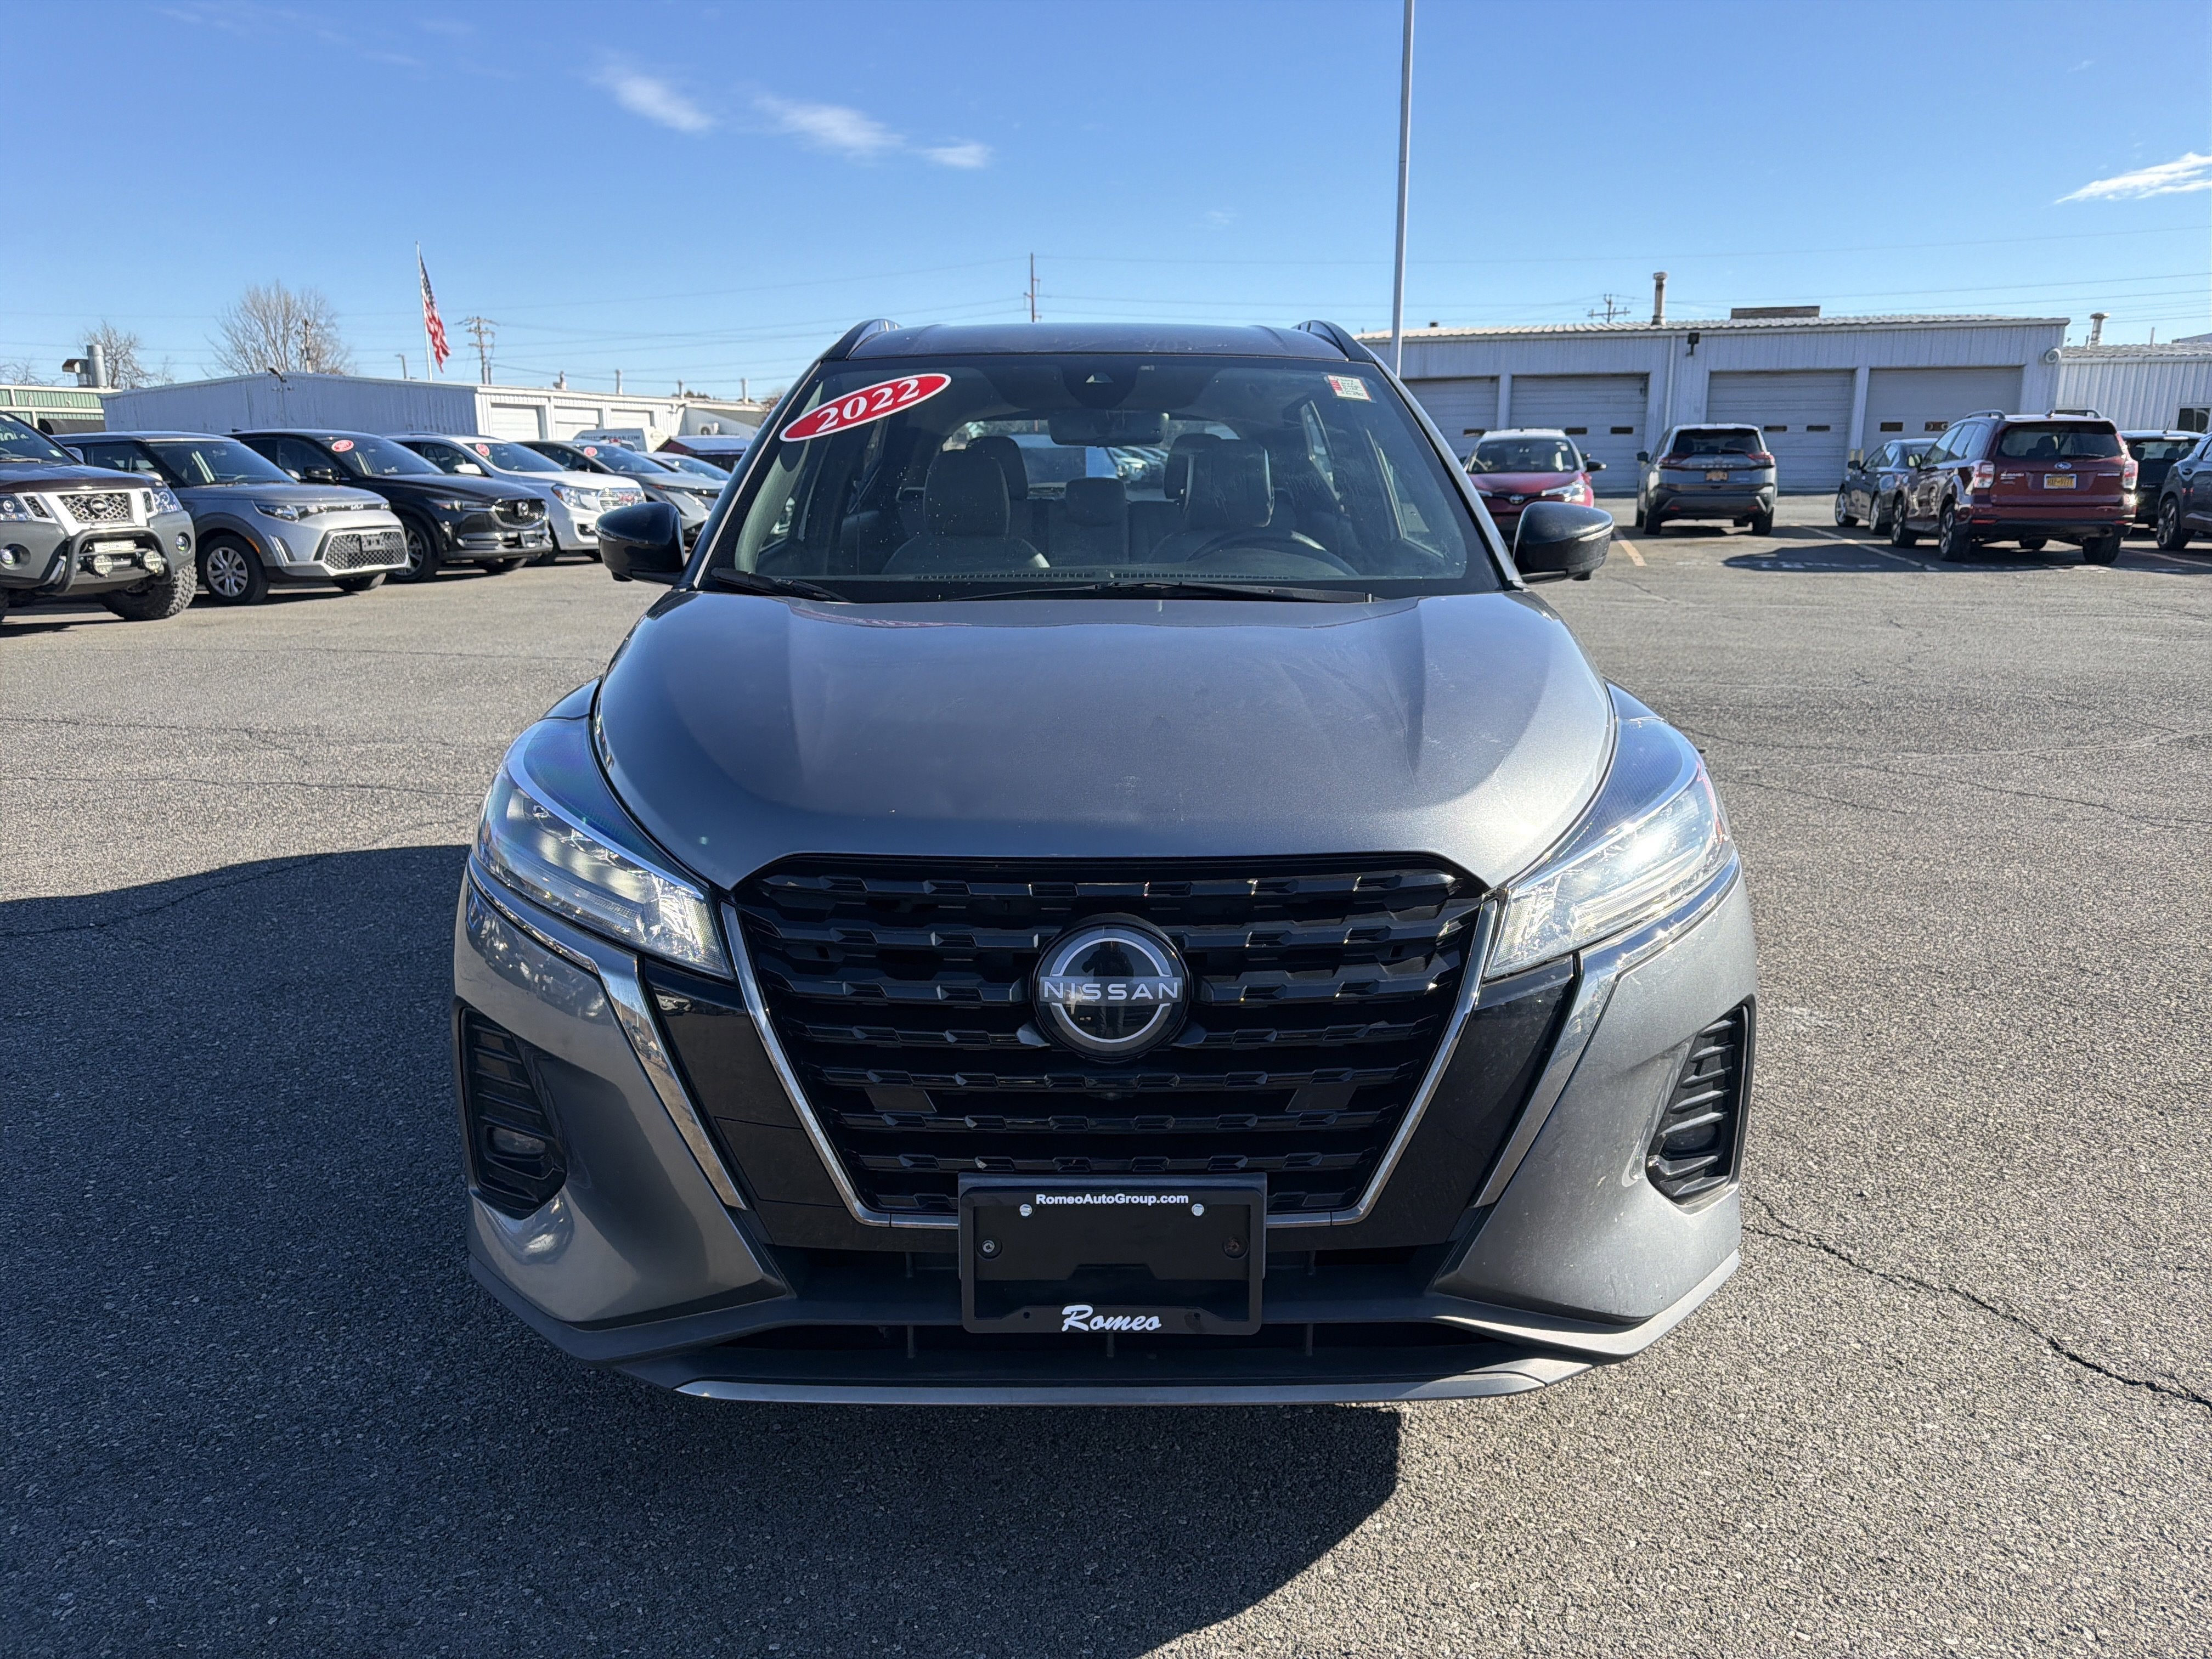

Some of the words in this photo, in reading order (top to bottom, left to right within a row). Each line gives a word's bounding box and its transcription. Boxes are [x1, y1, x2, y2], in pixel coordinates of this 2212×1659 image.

[815, 379, 919, 432] 2022
[1044, 981, 1178, 1000] NISSAN
[1036, 1194, 1189, 1205] RomeoAutoGroup.com
[1062, 1305, 1161, 1332] Romeo
